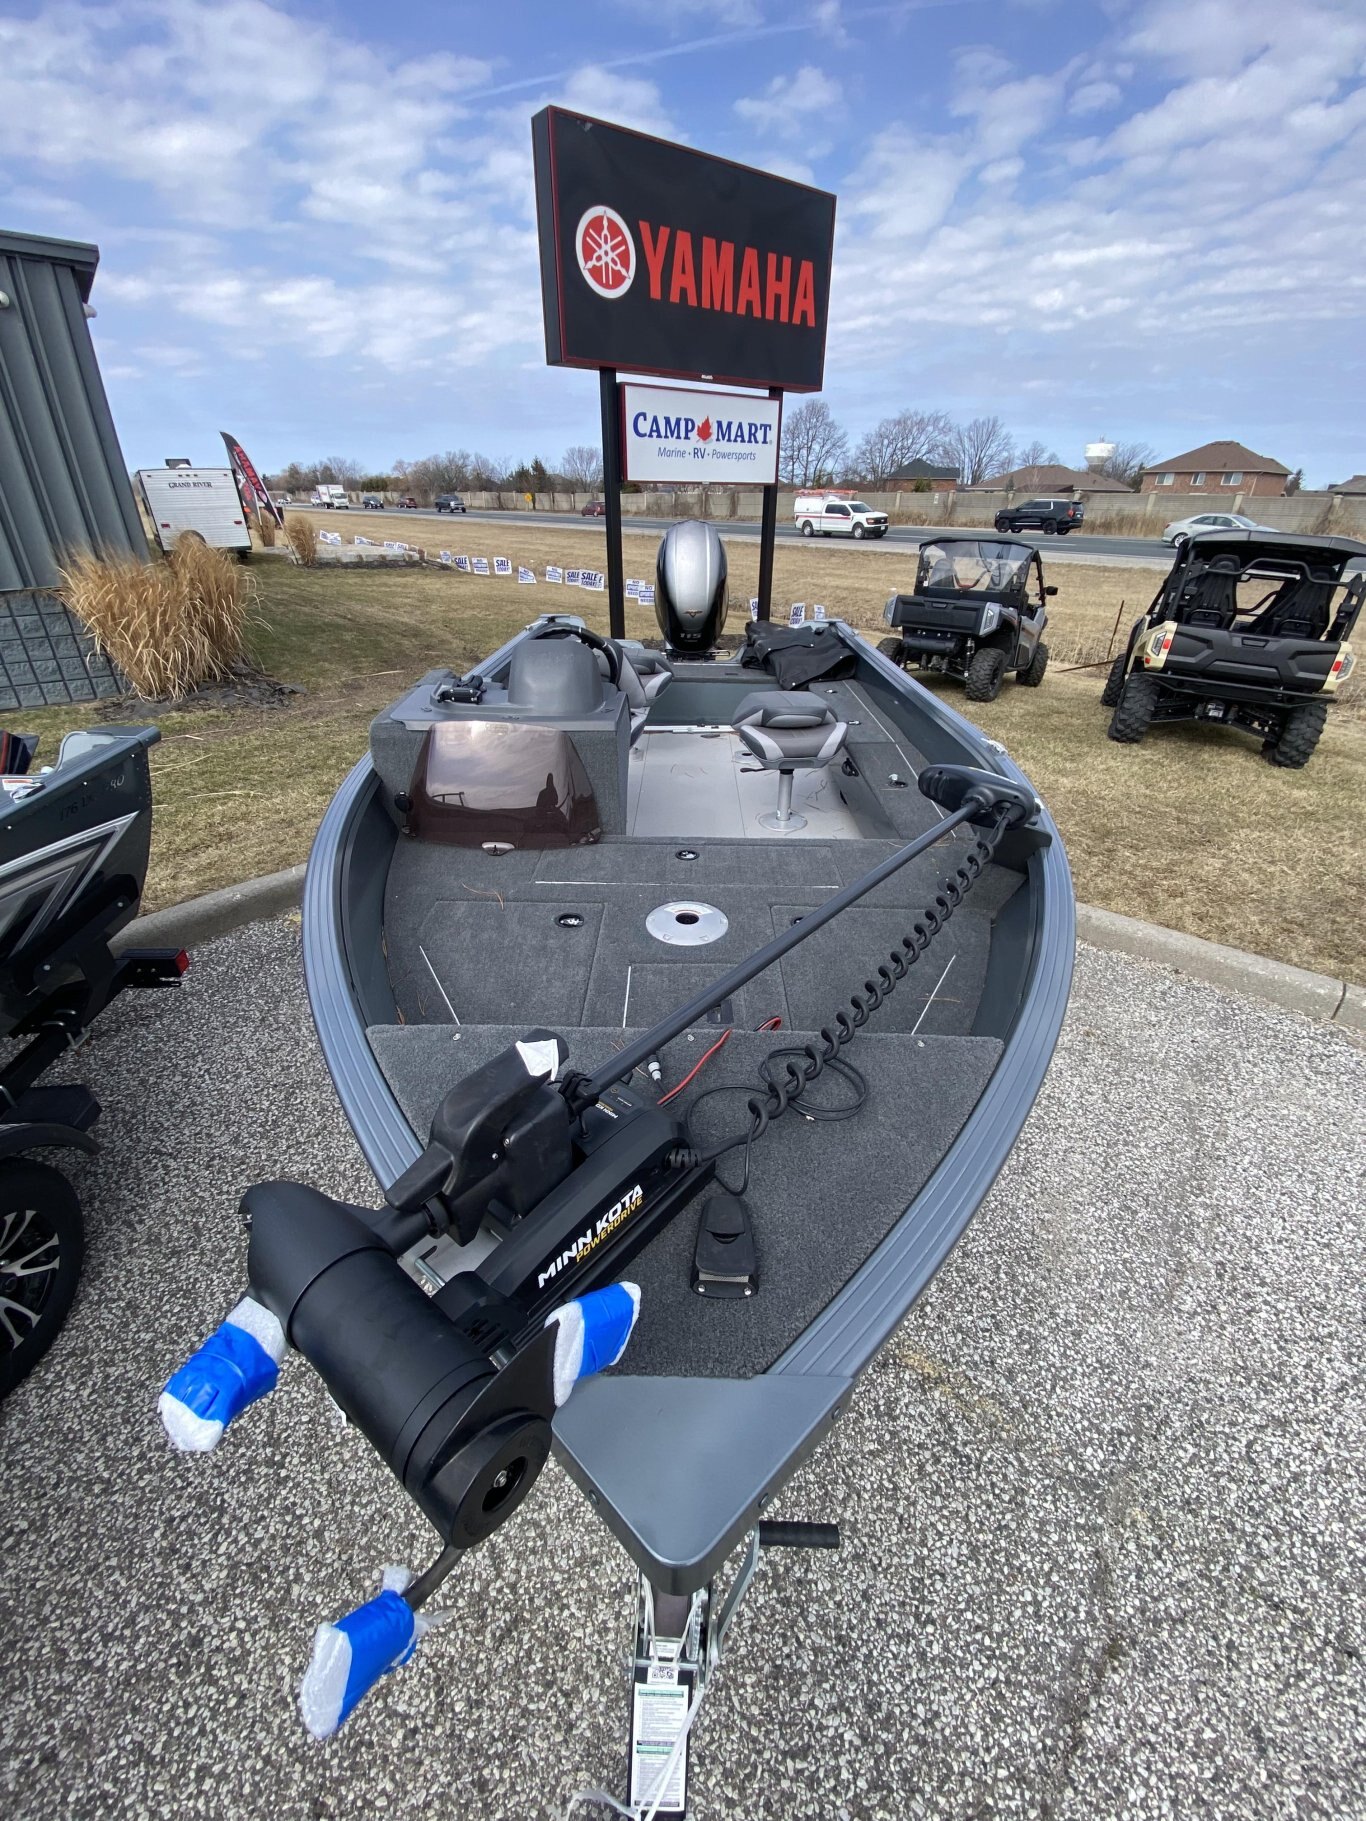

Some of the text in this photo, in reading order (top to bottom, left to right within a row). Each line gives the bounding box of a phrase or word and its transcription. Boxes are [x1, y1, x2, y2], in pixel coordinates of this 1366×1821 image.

[639, 220, 815, 327] YAMAHA
[632, 412, 772, 444] CAMP MART
[657, 447, 756, 462] Marine RV Powersports
[581, 572, 598, 581] SALE
[791, 606, 804, 618] SALE
[538, 1184, 643, 1288] MINN KOTA
[576, 1195, 643, 1262] POWERDRIVE
